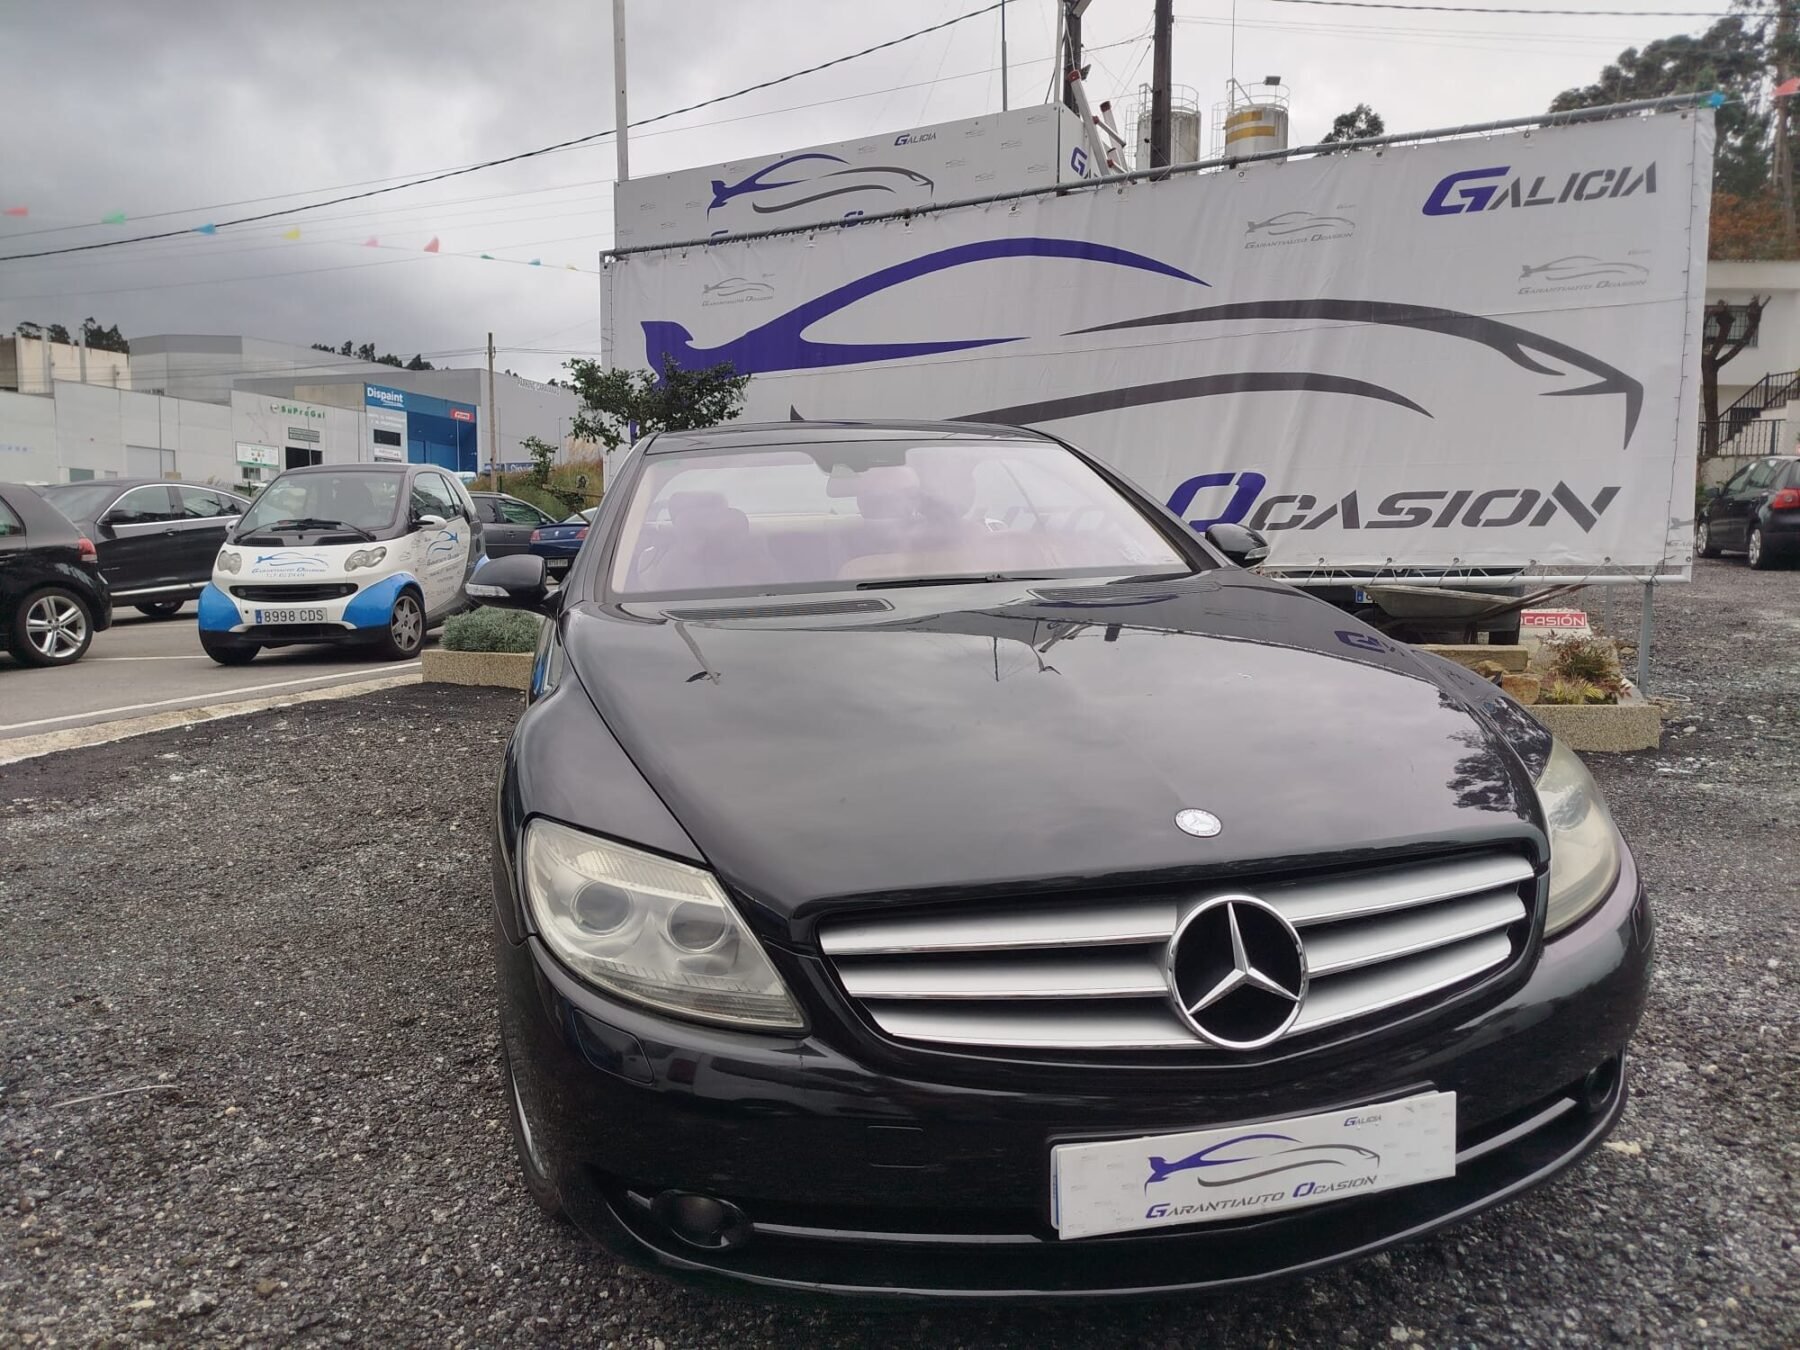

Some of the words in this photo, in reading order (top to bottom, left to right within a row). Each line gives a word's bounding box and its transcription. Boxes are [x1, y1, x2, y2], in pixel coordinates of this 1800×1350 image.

[894, 133, 937, 147] GALICIA
[1422, 160, 1657, 217] GALICIA
[367, 387, 404, 404] Dispaint
[1166, 471, 1622, 535] OCASION
[264, 610, 296, 623] 8998
[299, 609, 324, 622] CDS
[1146, 1191, 1285, 1220] GARANTIAUTO
[1292, 1174, 1378, 1199] OCASION
